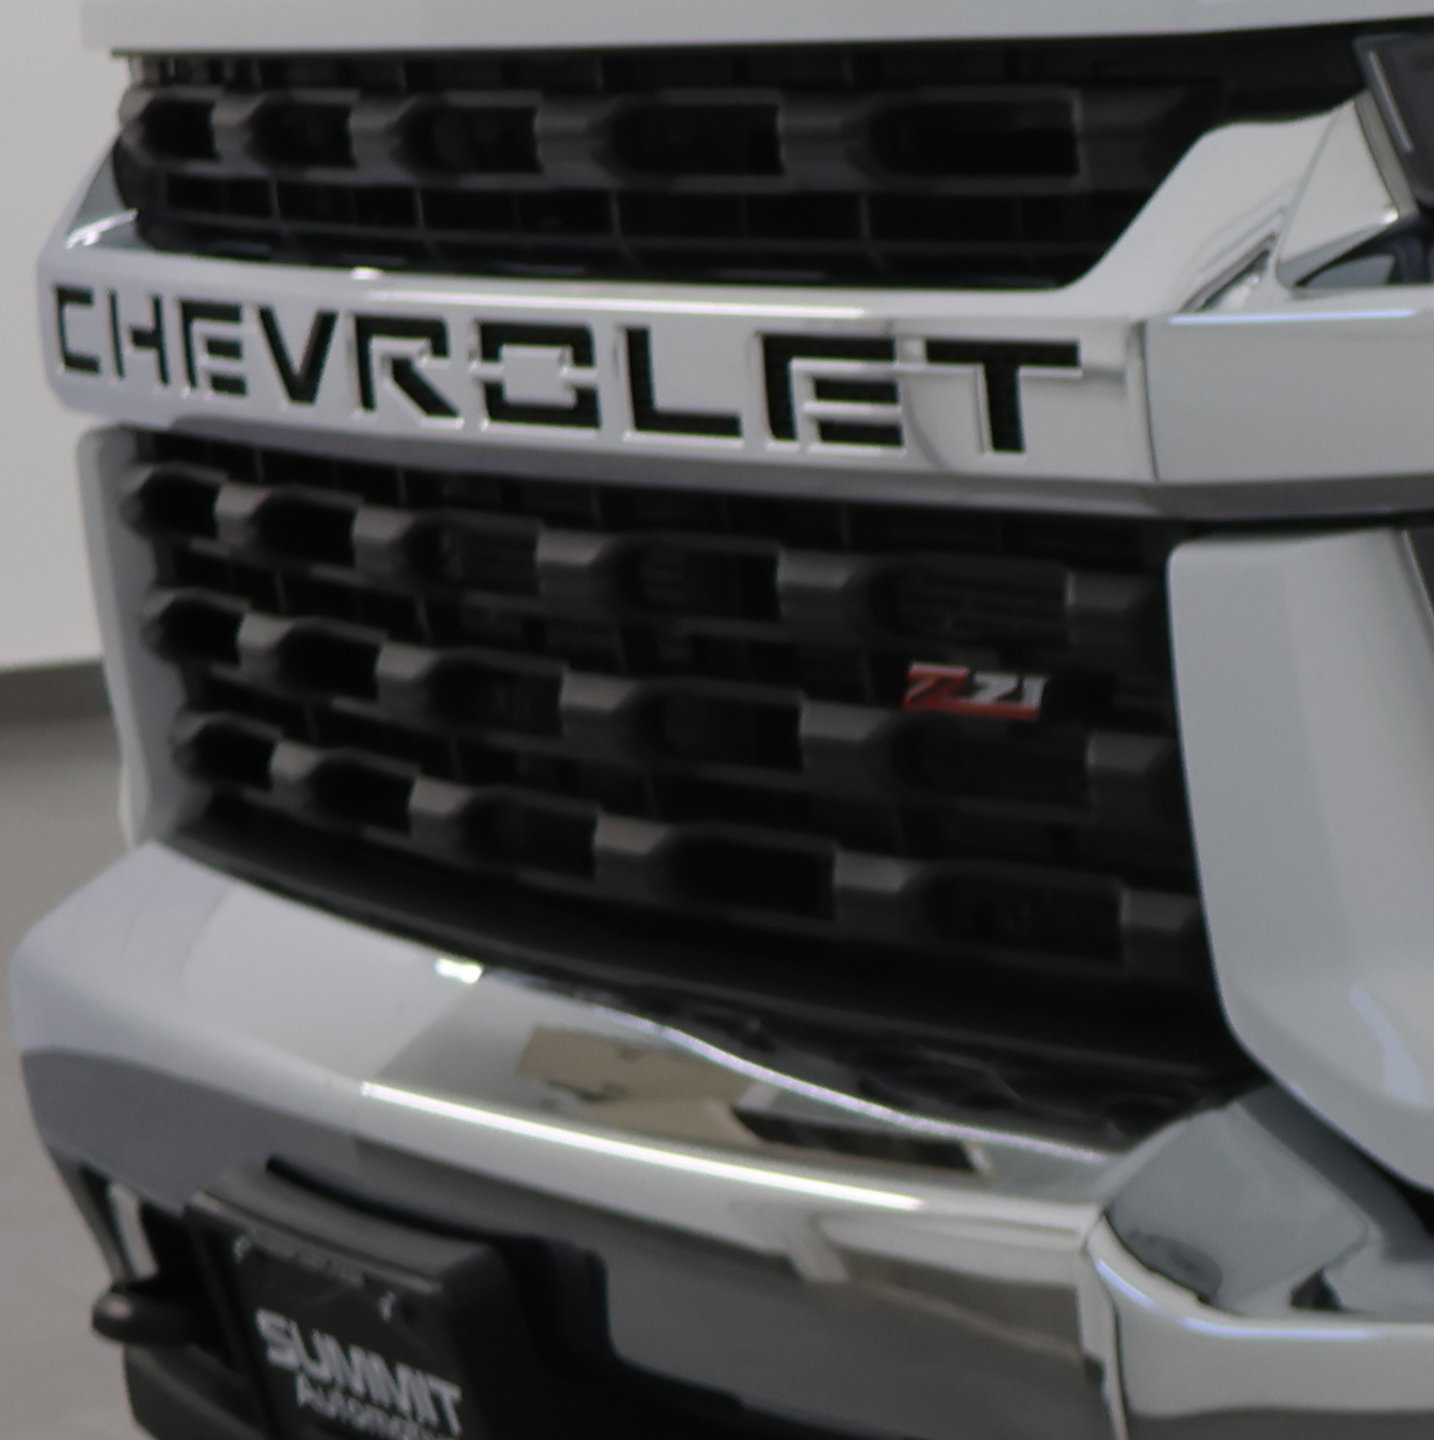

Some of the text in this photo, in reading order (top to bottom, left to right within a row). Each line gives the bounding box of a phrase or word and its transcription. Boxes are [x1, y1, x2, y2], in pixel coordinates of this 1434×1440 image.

[52, 285, 1082, 454] CHEVROLET
[902, 662, 1046, 721] Z71
[256, 1308, 461, 1434] SUMMIT
